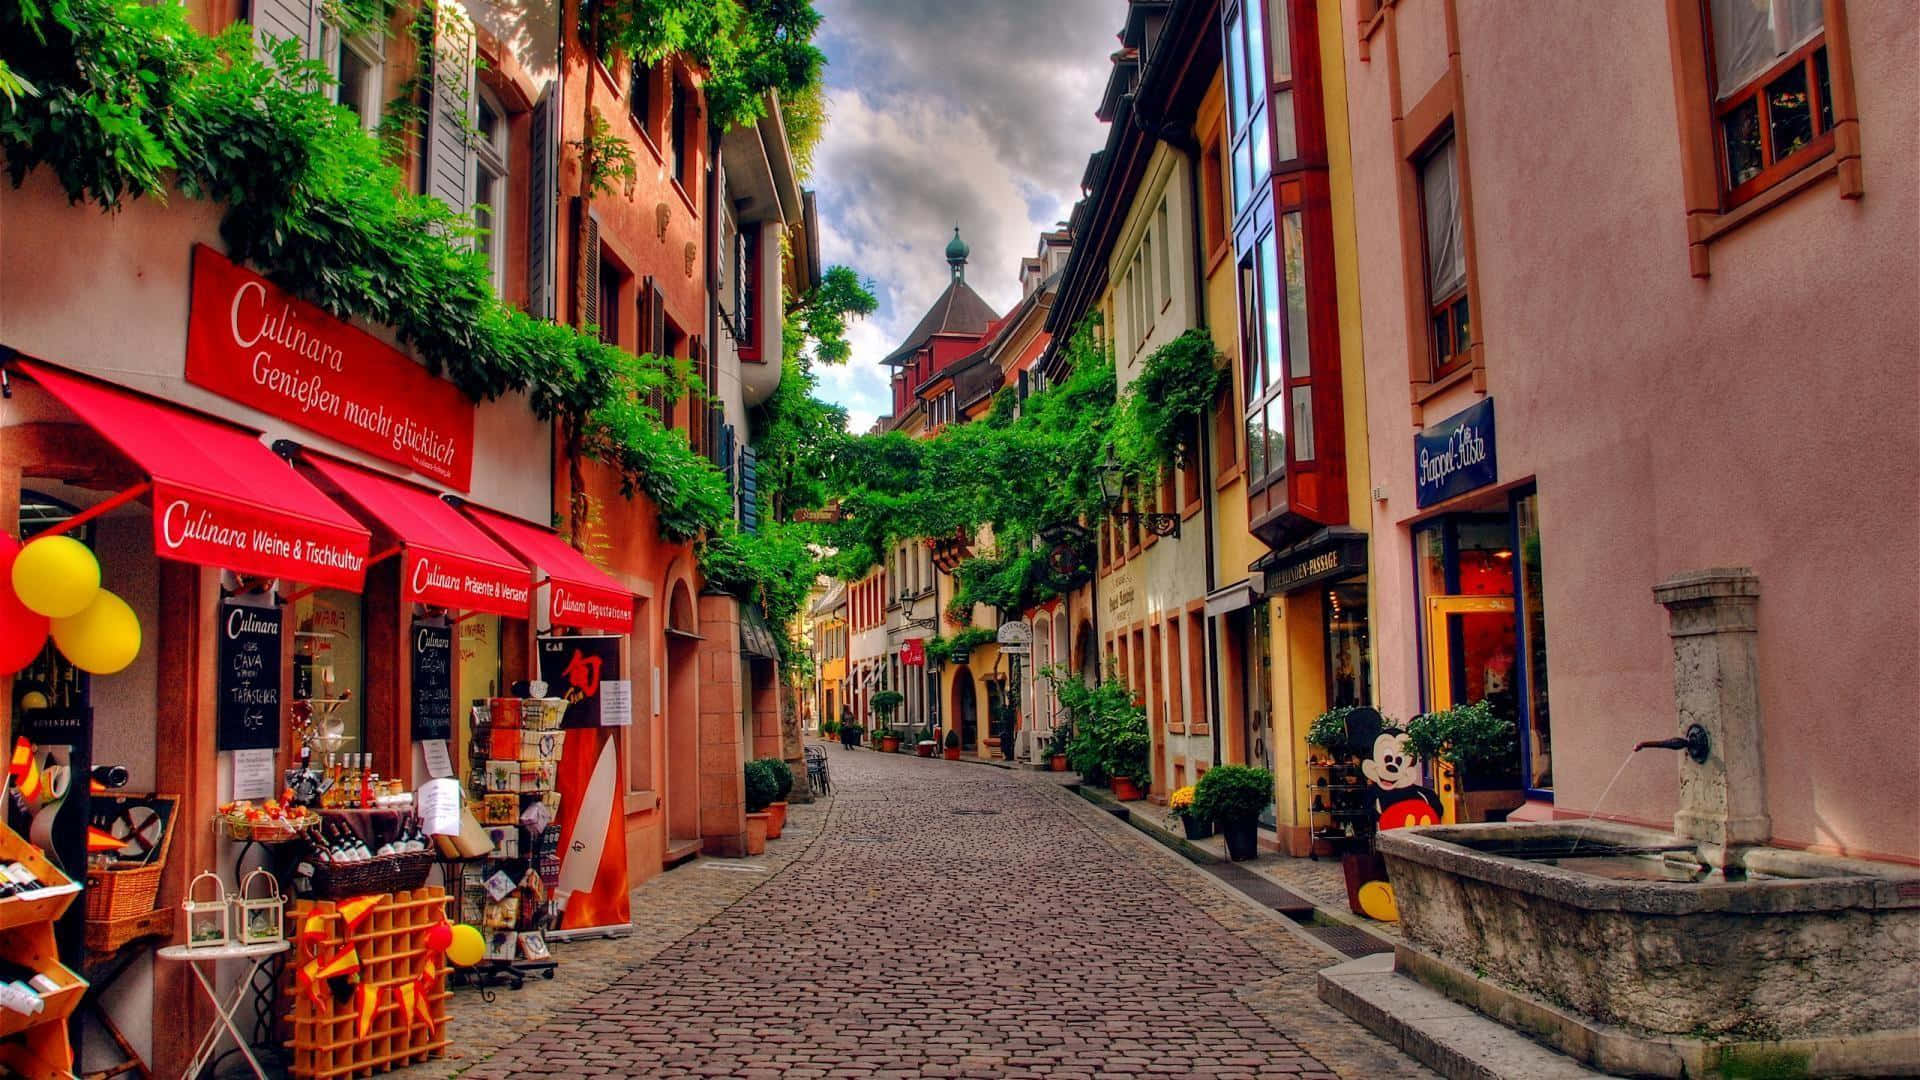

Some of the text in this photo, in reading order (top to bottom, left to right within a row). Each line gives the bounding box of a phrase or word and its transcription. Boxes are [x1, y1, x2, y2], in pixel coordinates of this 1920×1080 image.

[231, 281, 344, 372] Culinara
[252, 351, 341, 417] Genießen
[343, 400, 393, 438] macht
[393, 418, 455, 467] glücklich
[163, 500, 363, 572] Culinara Weine & Tischkultur
[412, 557, 528, 603] Culinara Präsente & Versand
[553, 588, 586, 618] Culinara
[227, 608, 278, 639] Culinara
[417, 628, 448, 653] Culinara
[233, 653, 263, 670] CAVA
